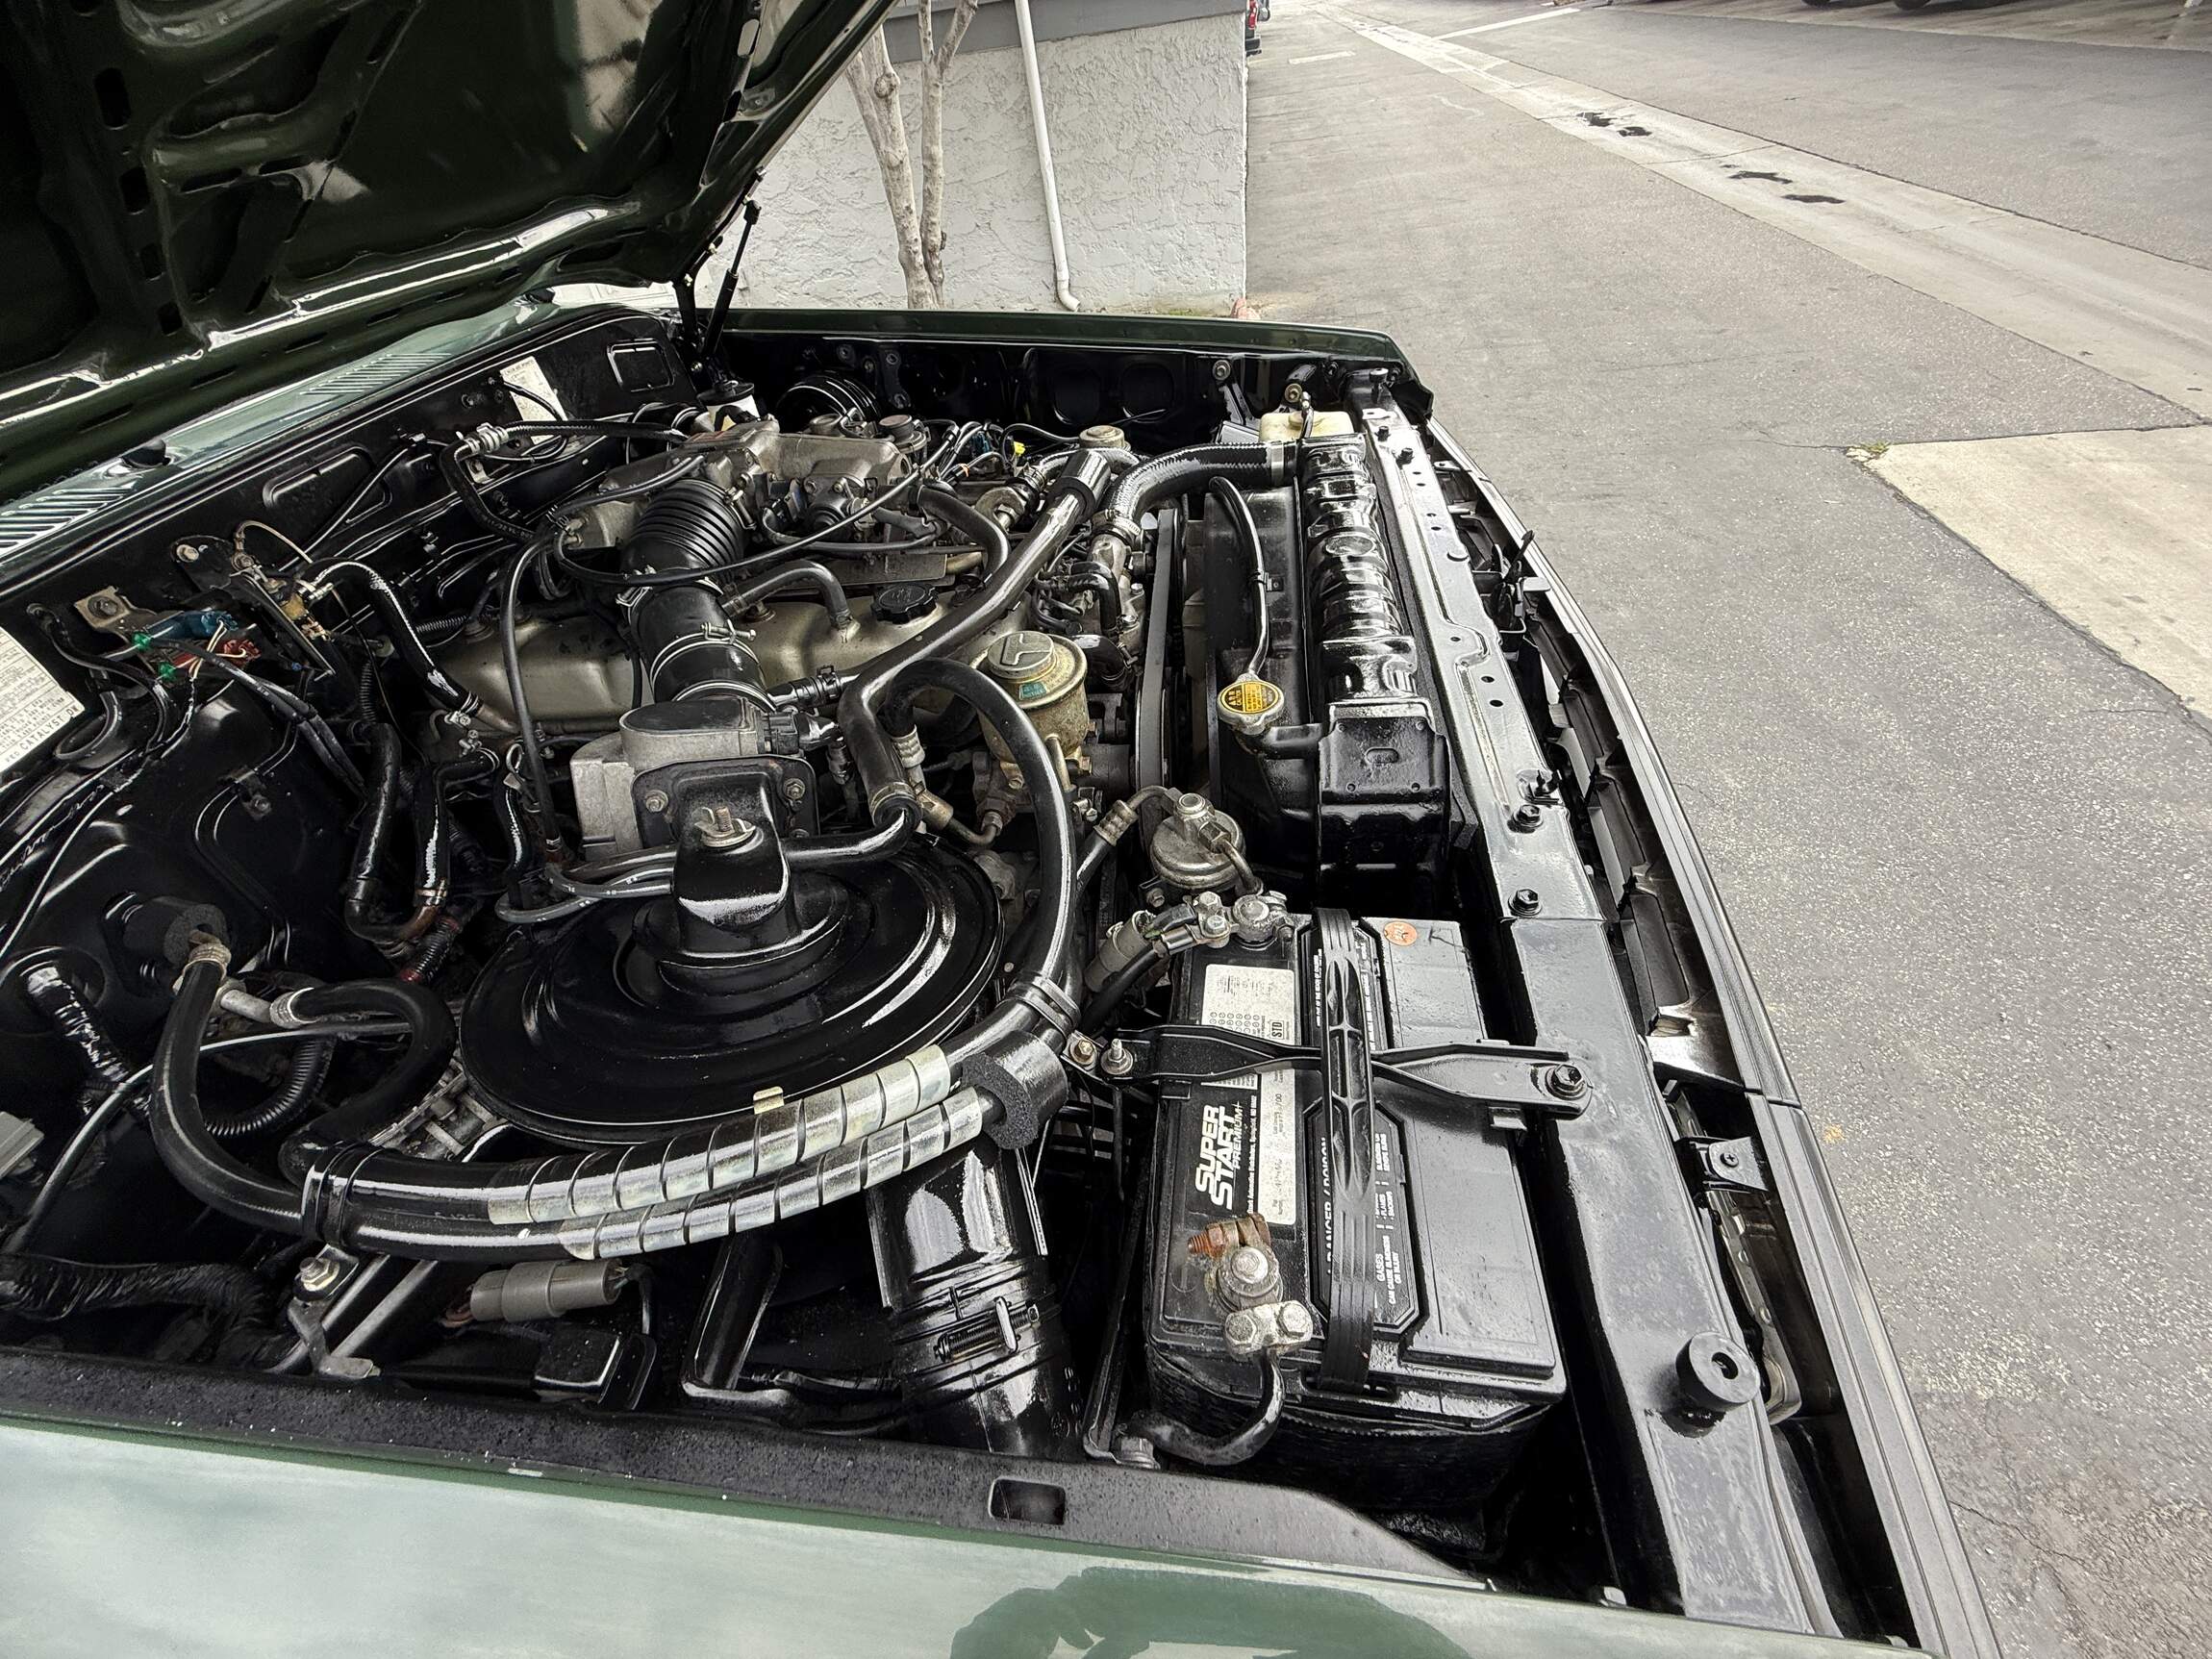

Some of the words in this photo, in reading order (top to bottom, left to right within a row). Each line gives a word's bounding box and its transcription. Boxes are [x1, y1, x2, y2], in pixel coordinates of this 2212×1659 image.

[19, 715, 65, 750] CATALYST
[1271, 1021, 1282, 1037] STD
[1194, 1105, 1219, 1194] SUPER
[1210, 1106, 1234, 1210] START
[1375, 1253, 1385, 1281] GASES
